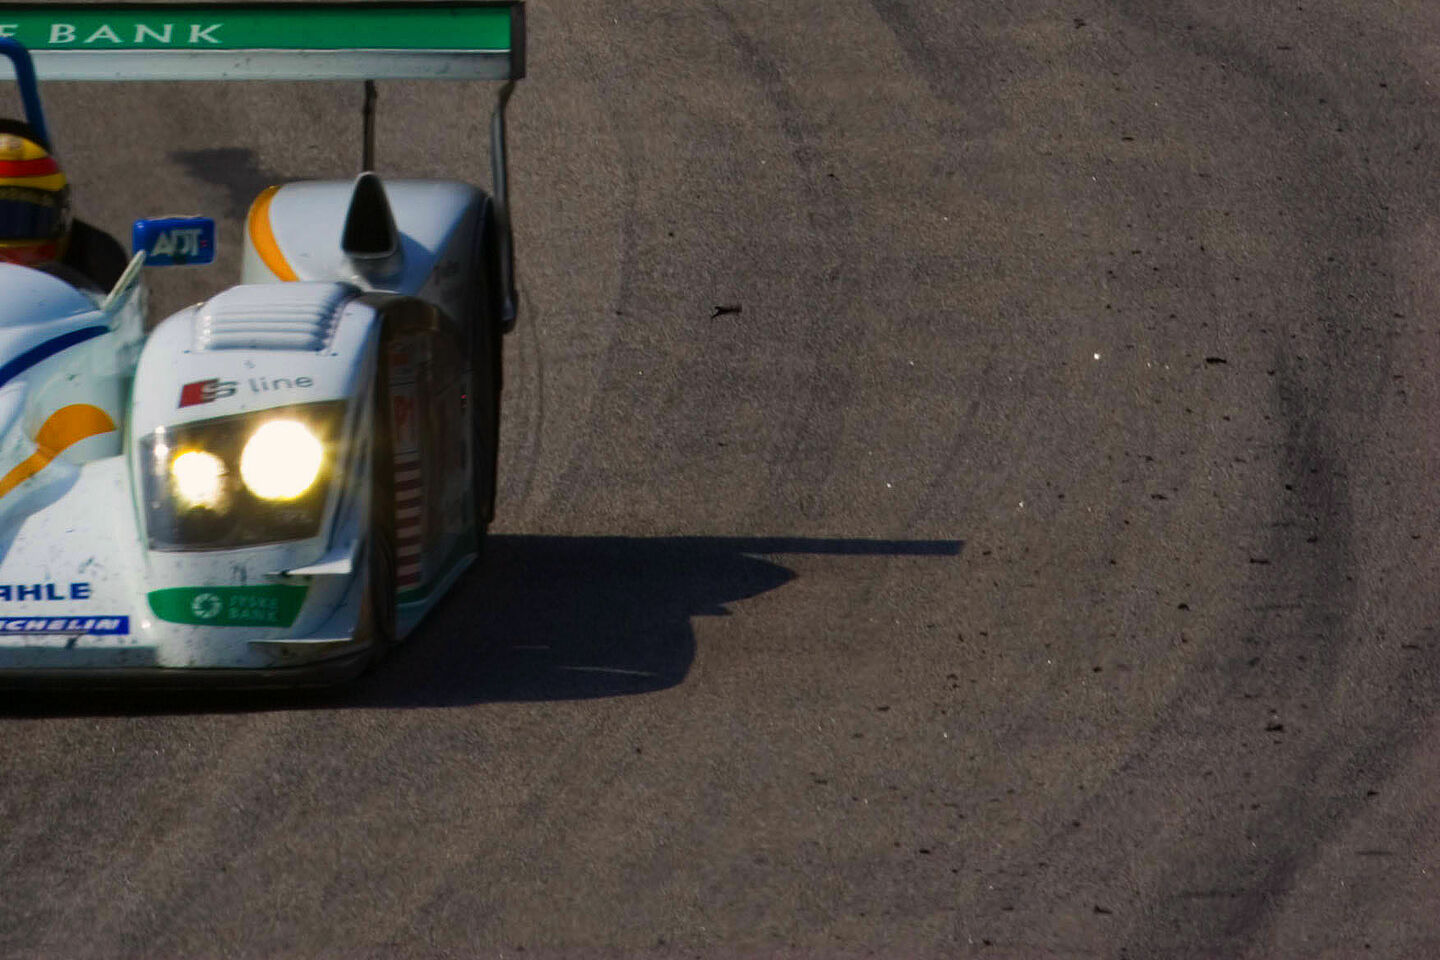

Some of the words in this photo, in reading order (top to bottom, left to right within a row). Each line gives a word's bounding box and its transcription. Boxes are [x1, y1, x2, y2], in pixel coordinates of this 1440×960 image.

[47, 24, 225, 43] BANK
[150, 228, 204, 257] ADT
[248, 376, 314, 393] line
